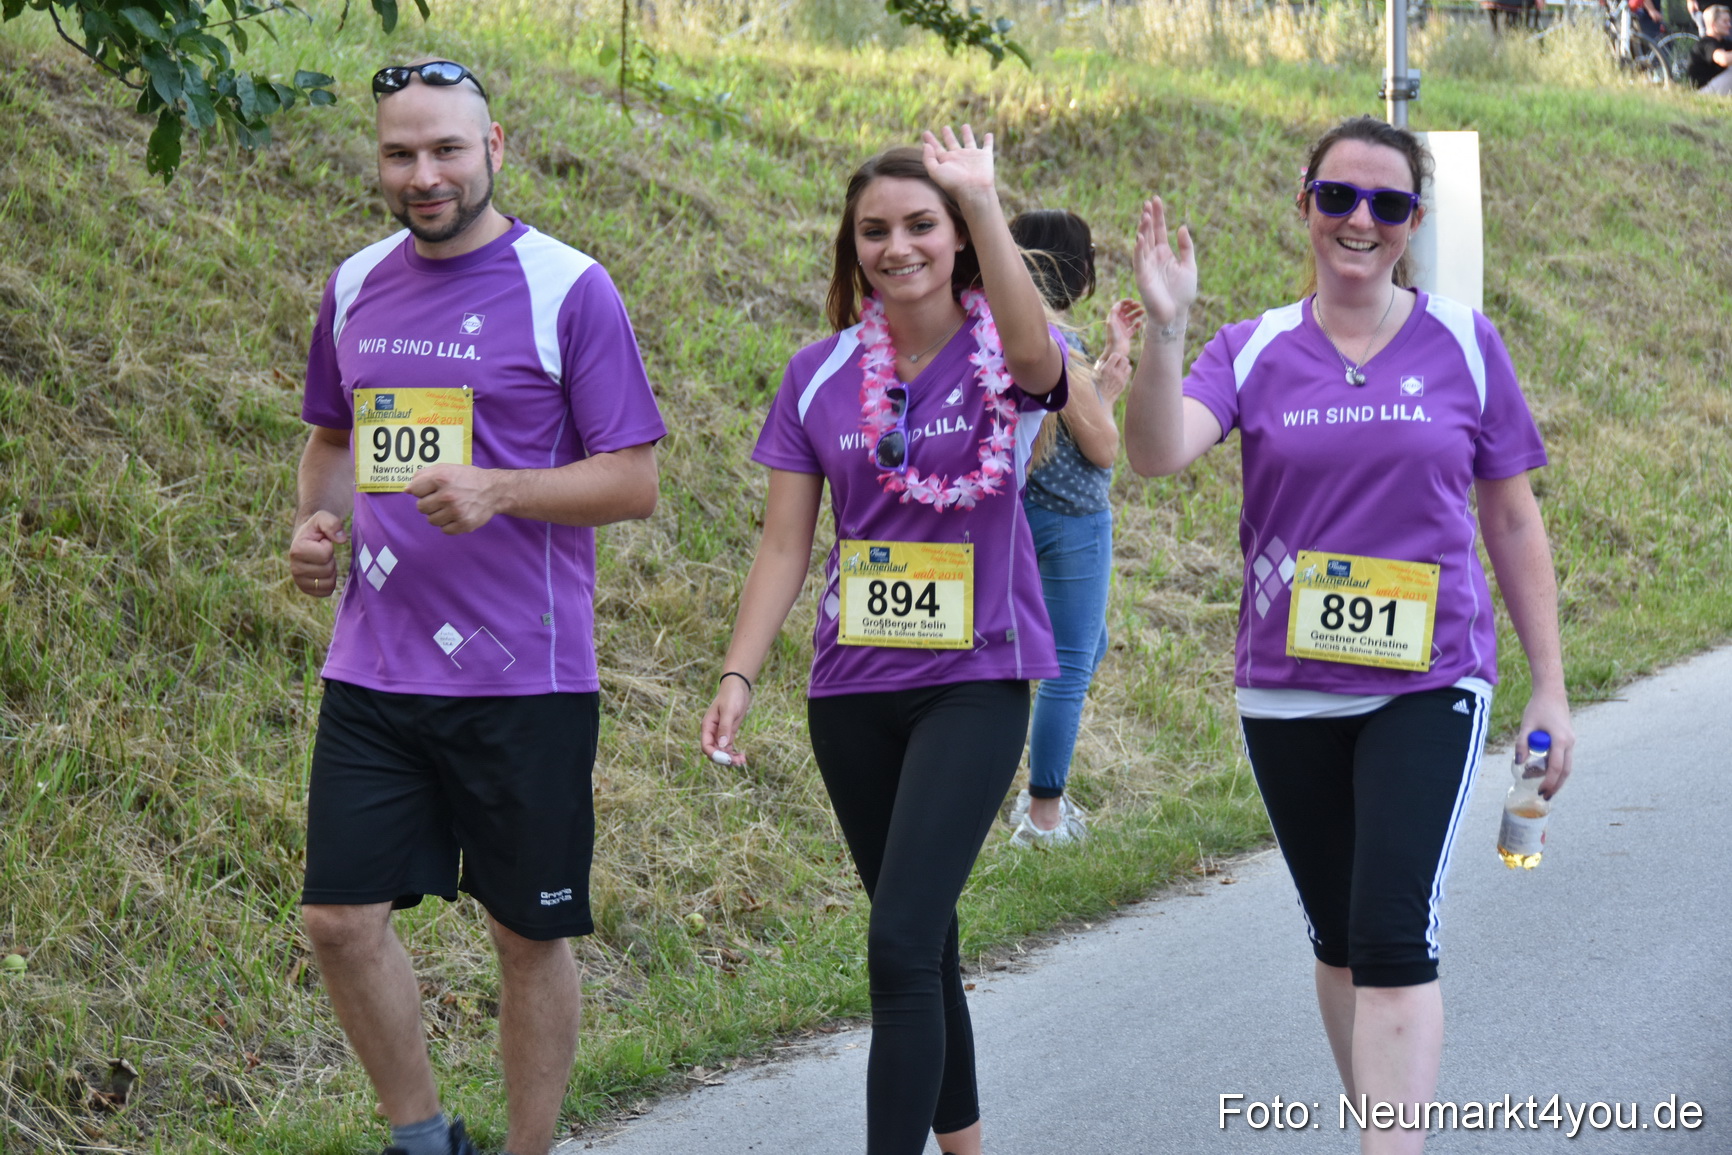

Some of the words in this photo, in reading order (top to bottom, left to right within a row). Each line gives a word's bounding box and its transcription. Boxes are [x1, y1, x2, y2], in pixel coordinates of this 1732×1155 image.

[359, 338, 387, 354] WIR
[391, 338, 433, 356] SIND
[436, 341, 482, 361] LILA.
[924, 415, 973, 437] LILA.
[1283, 408, 1319, 427] WIR
[1326, 405, 1374, 424] SIND
[1380, 404, 1432, 423] LILA.
[373, 426, 441, 463] 908
[372, 464, 414, 474] Nawrocki
[867, 580, 940, 618] 894
[921, 620, 946, 630] Selin
[1320, 593, 1397, 637] 891
[864, 628, 886, 636] FUCHS
[918, 630, 943, 638] Service
[1310, 630, 1356, 644] Gerstner
[1359, 636, 1408, 651] Christine
[1314, 642, 1340, 650] FUCHS
[1374, 649, 1401, 658] Service
